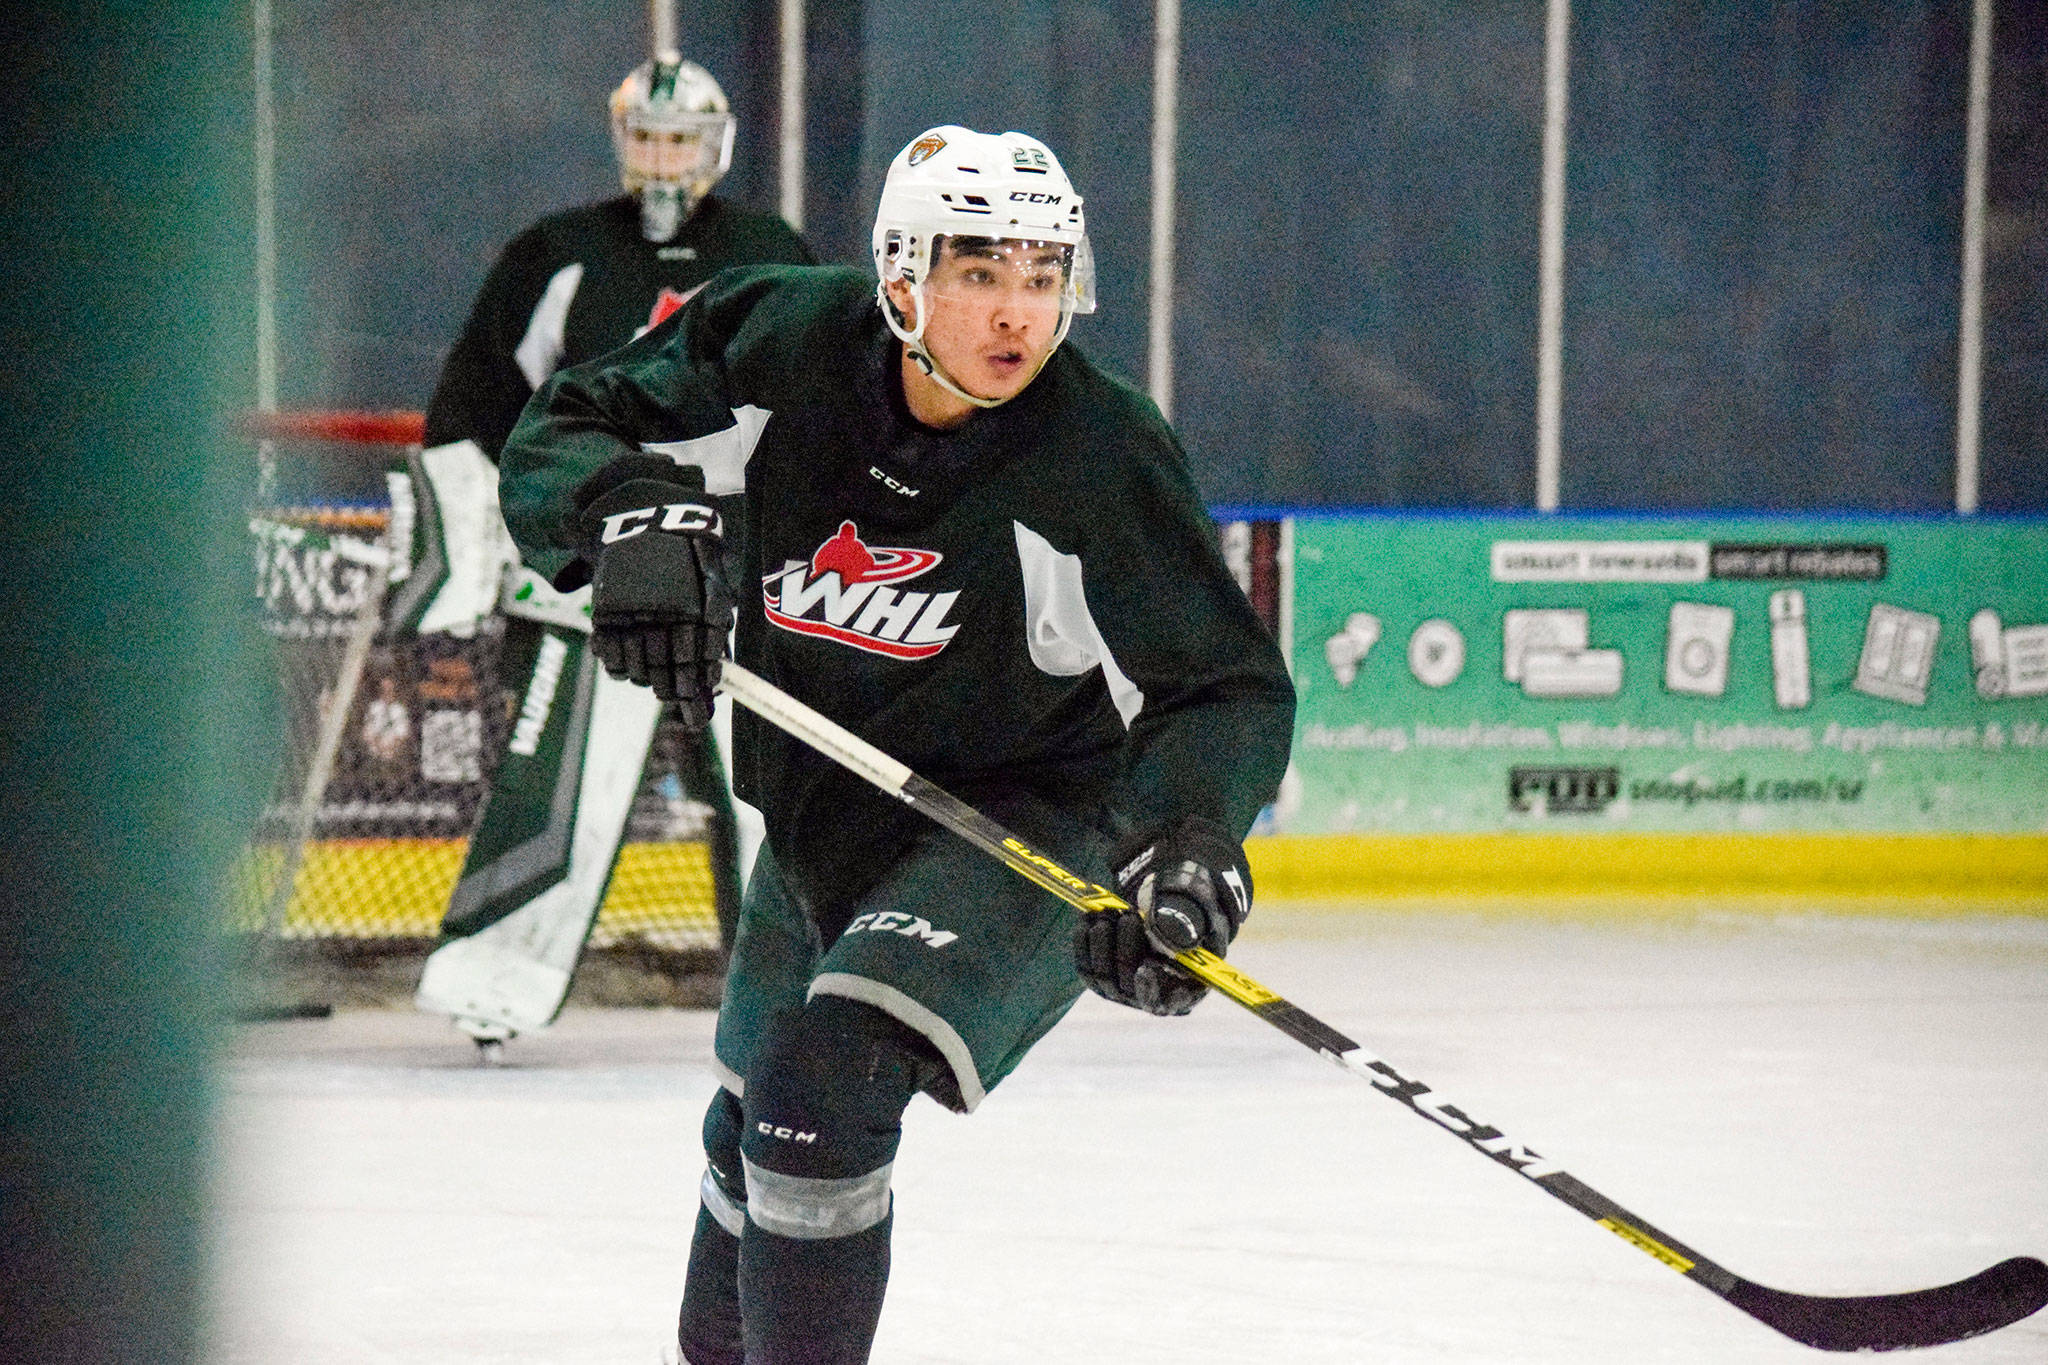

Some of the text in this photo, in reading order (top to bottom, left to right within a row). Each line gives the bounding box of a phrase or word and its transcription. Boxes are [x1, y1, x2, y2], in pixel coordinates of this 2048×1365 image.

[1012, 147, 1050, 168] 22
[1009, 191, 1062, 205] CCM
[869, 466, 920, 497] CCM
[779, 559, 962, 644] WHL
[1002, 837, 1087, 889] SUPER
[843, 911, 959, 948] CCM
[1340, 1046, 1556, 1180] CCM
[758, 1121, 817, 1145] CCM
